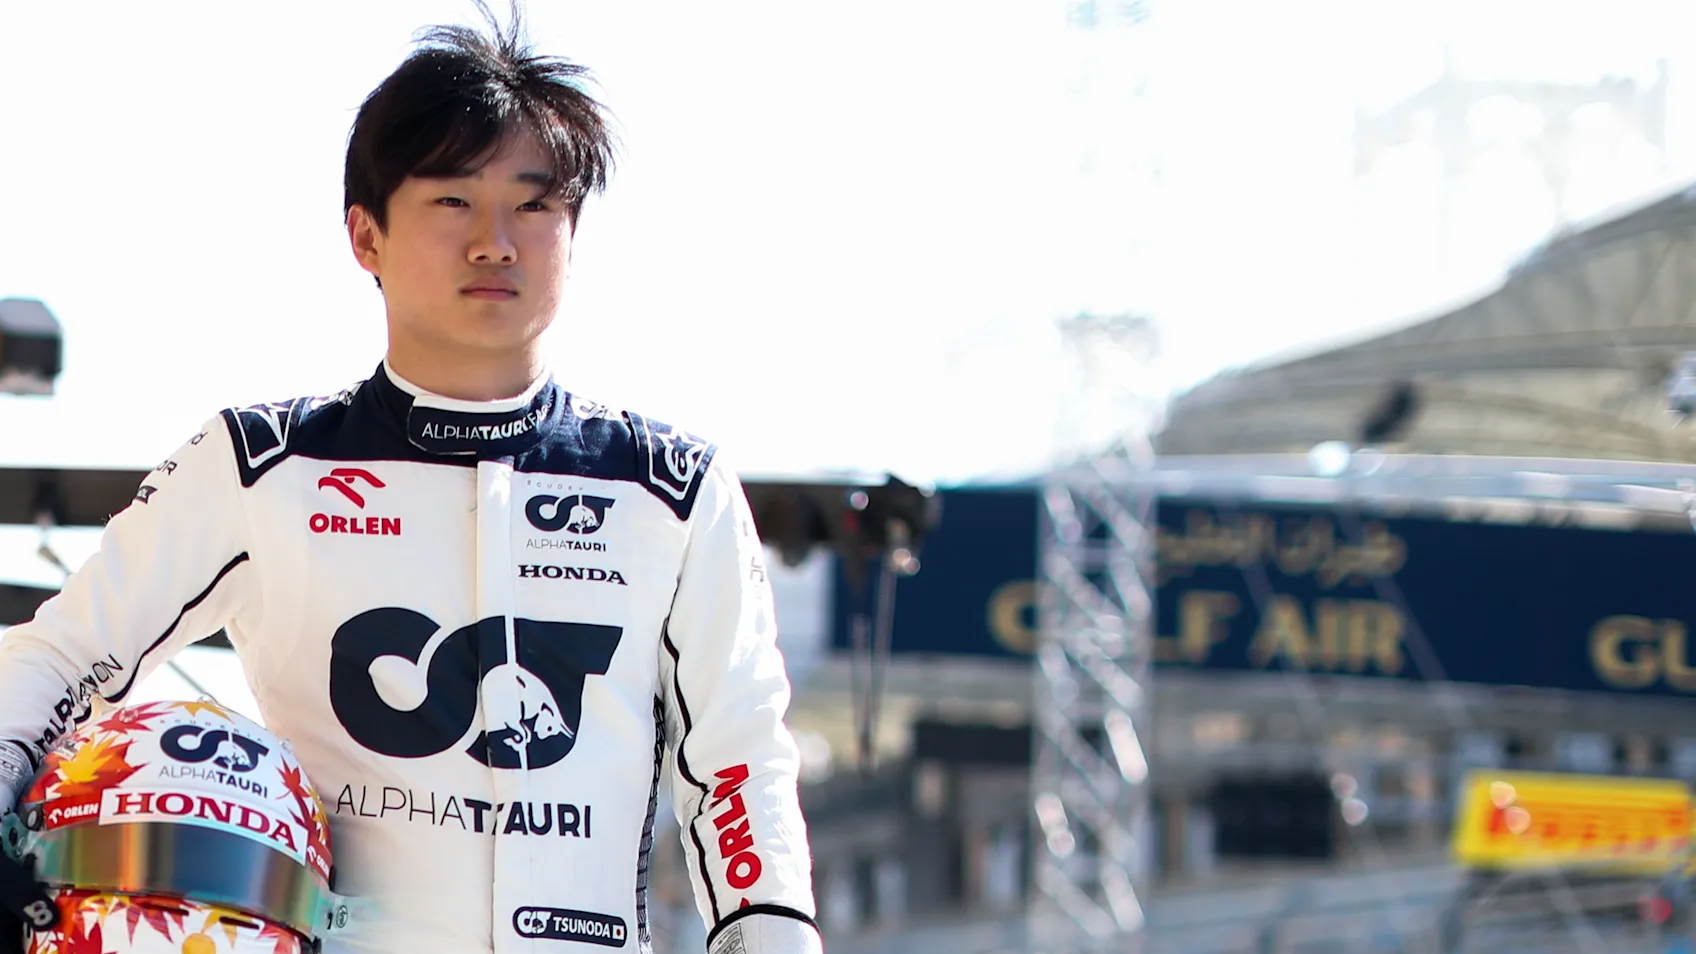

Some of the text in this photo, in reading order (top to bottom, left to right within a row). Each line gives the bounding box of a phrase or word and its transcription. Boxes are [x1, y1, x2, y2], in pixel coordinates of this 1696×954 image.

[309, 513, 401, 536] ORLEN
[526, 538, 607, 552] ALPHATAURI
[518, 564, 628, 586] HONDA
[1247, 593, 1406, 674] AIR
[159, 766, 268, 799] ALPHATAURI
[63, 803, 99, 819] ORLEN
[112, 792, 298, 853] HONDA
[336, 784, 592, 838] ALPHATAURI
[552, 916, 611, 938] TSUNODA
